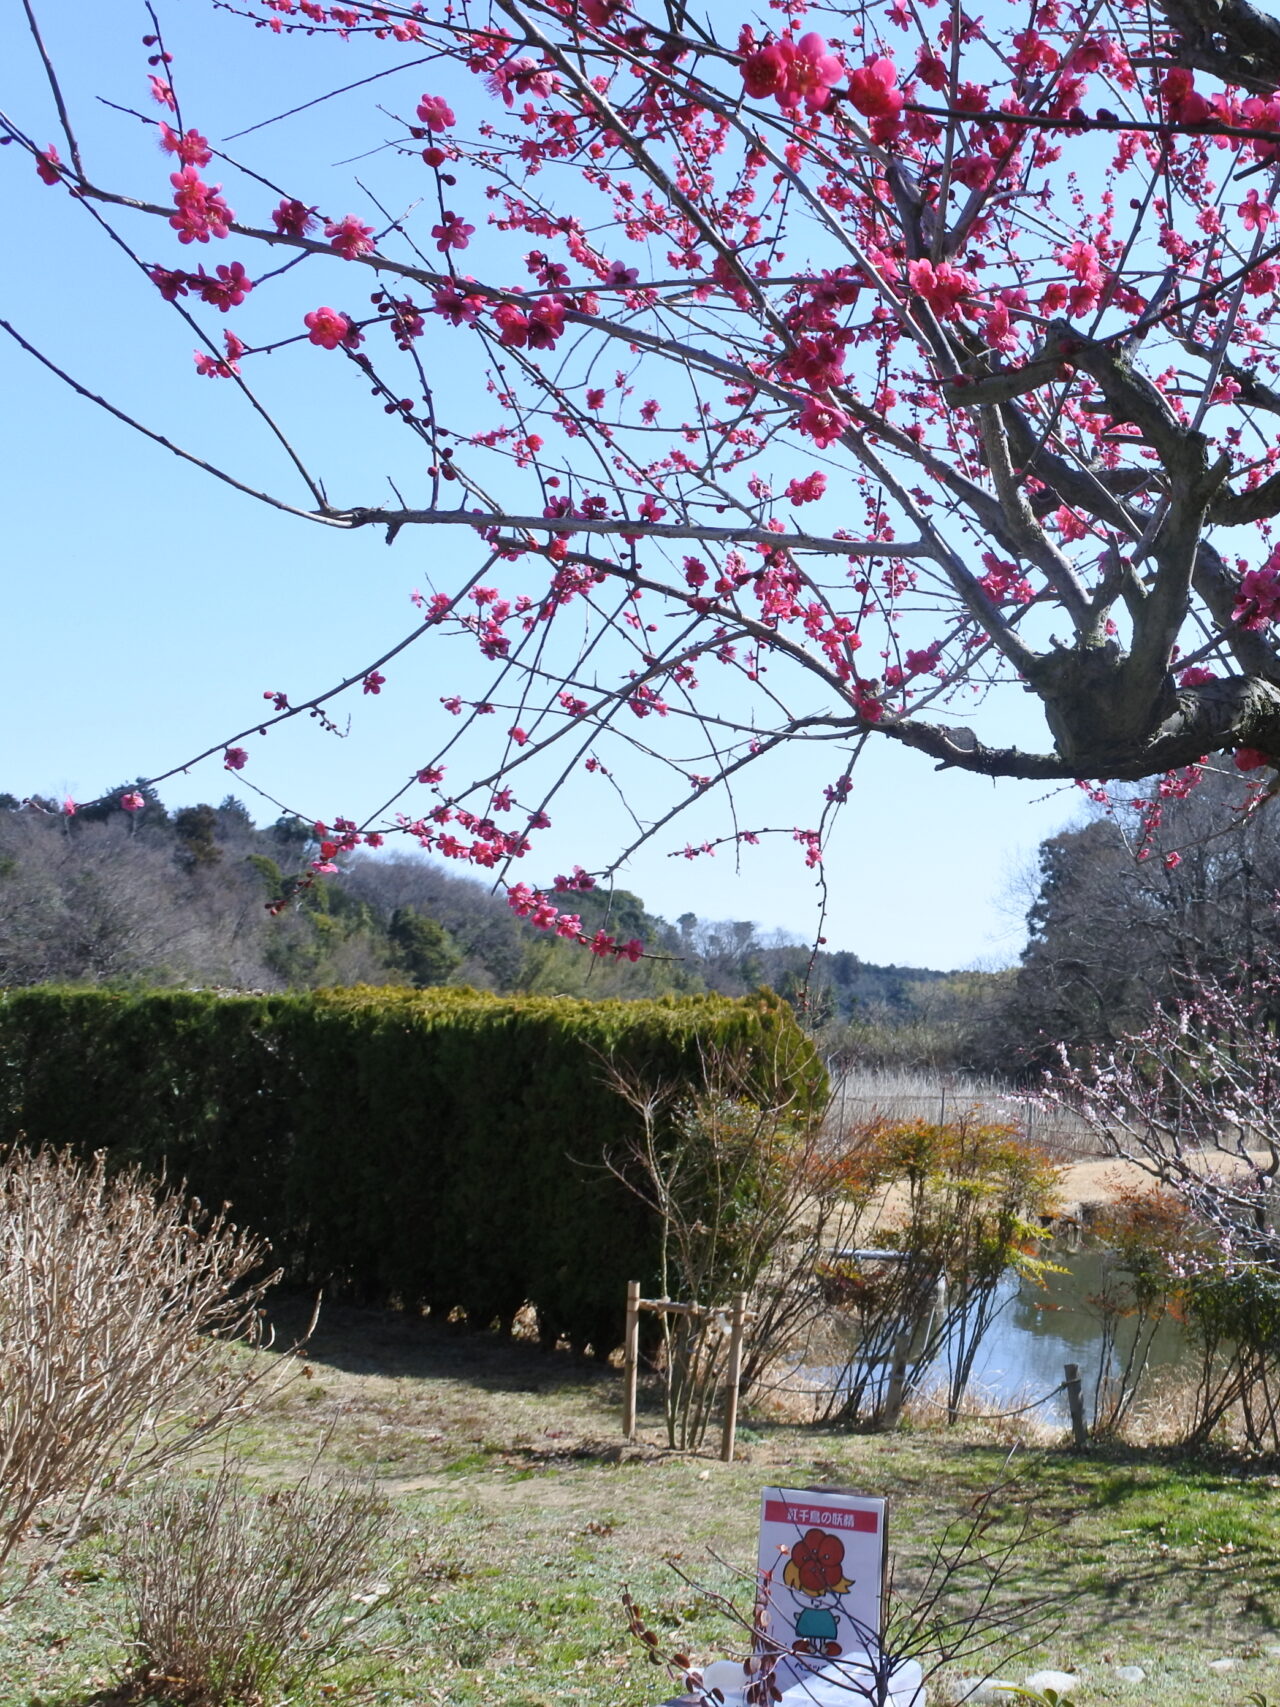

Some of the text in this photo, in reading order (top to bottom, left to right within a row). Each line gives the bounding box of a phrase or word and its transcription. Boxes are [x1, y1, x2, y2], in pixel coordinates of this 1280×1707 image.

[787, 1507, 855, 1528] 紅千鳥の妖精
